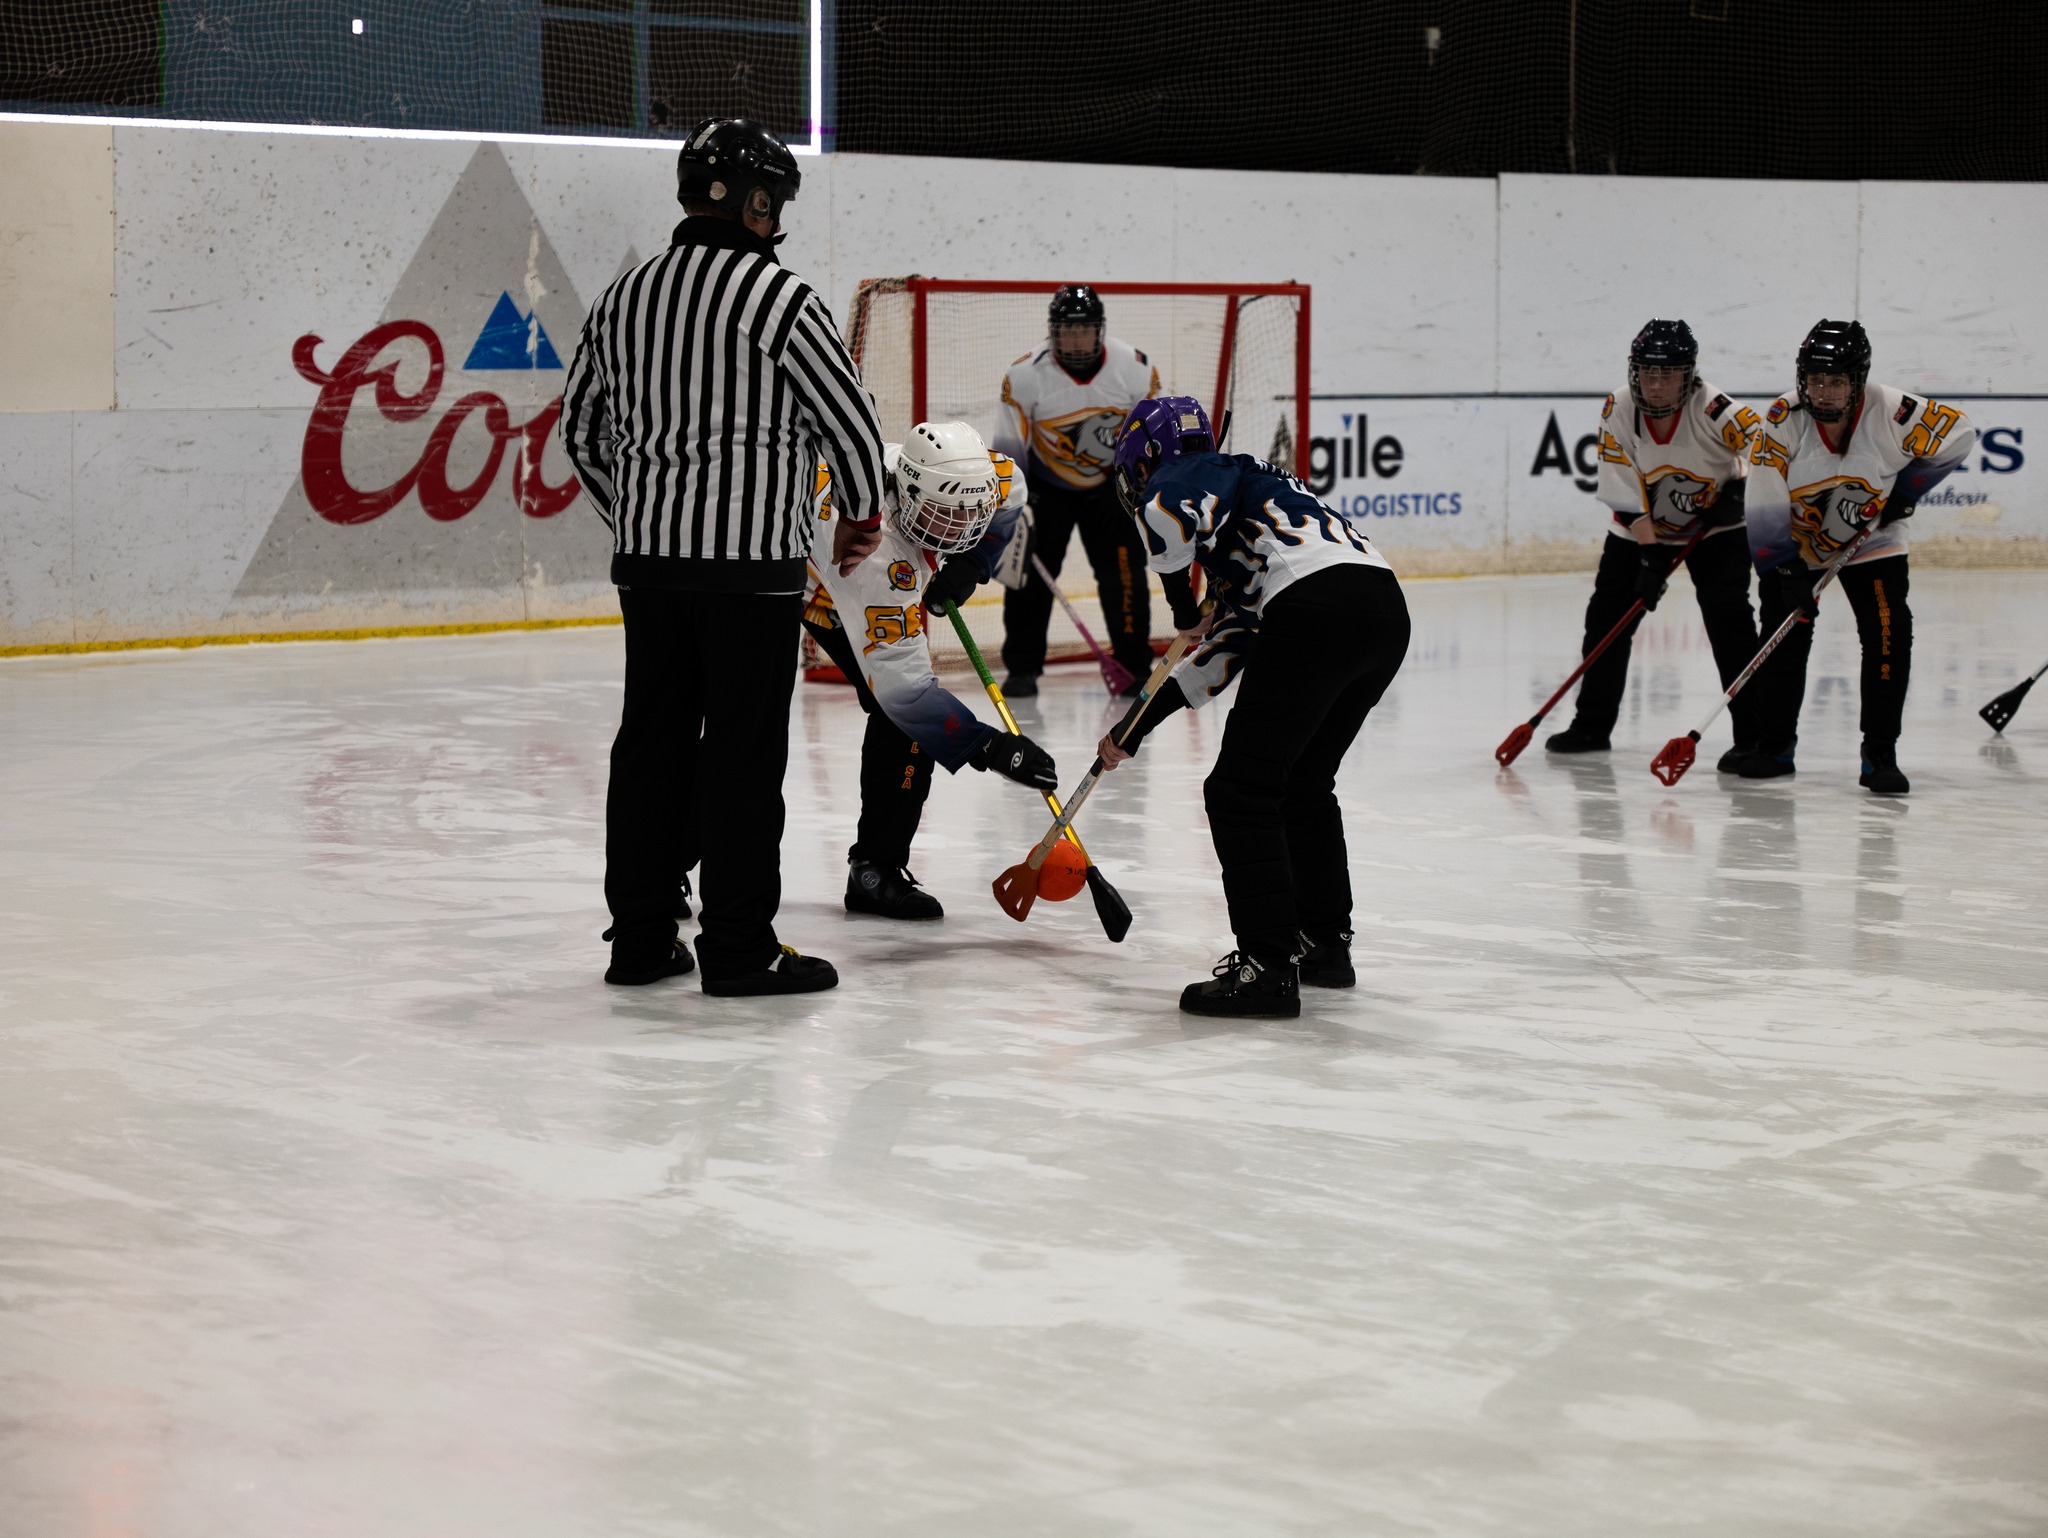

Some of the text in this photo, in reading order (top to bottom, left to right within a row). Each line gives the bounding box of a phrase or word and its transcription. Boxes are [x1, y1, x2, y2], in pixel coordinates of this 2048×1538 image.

[763, 164, 787, 176] BAUER
[1902, 399, 1960, 458] 25
[960, 487, 987, 495] ITECH
[1341, 492, 1462, 518] LOGISTICS
[1880, 662, 1891, 681] SA
